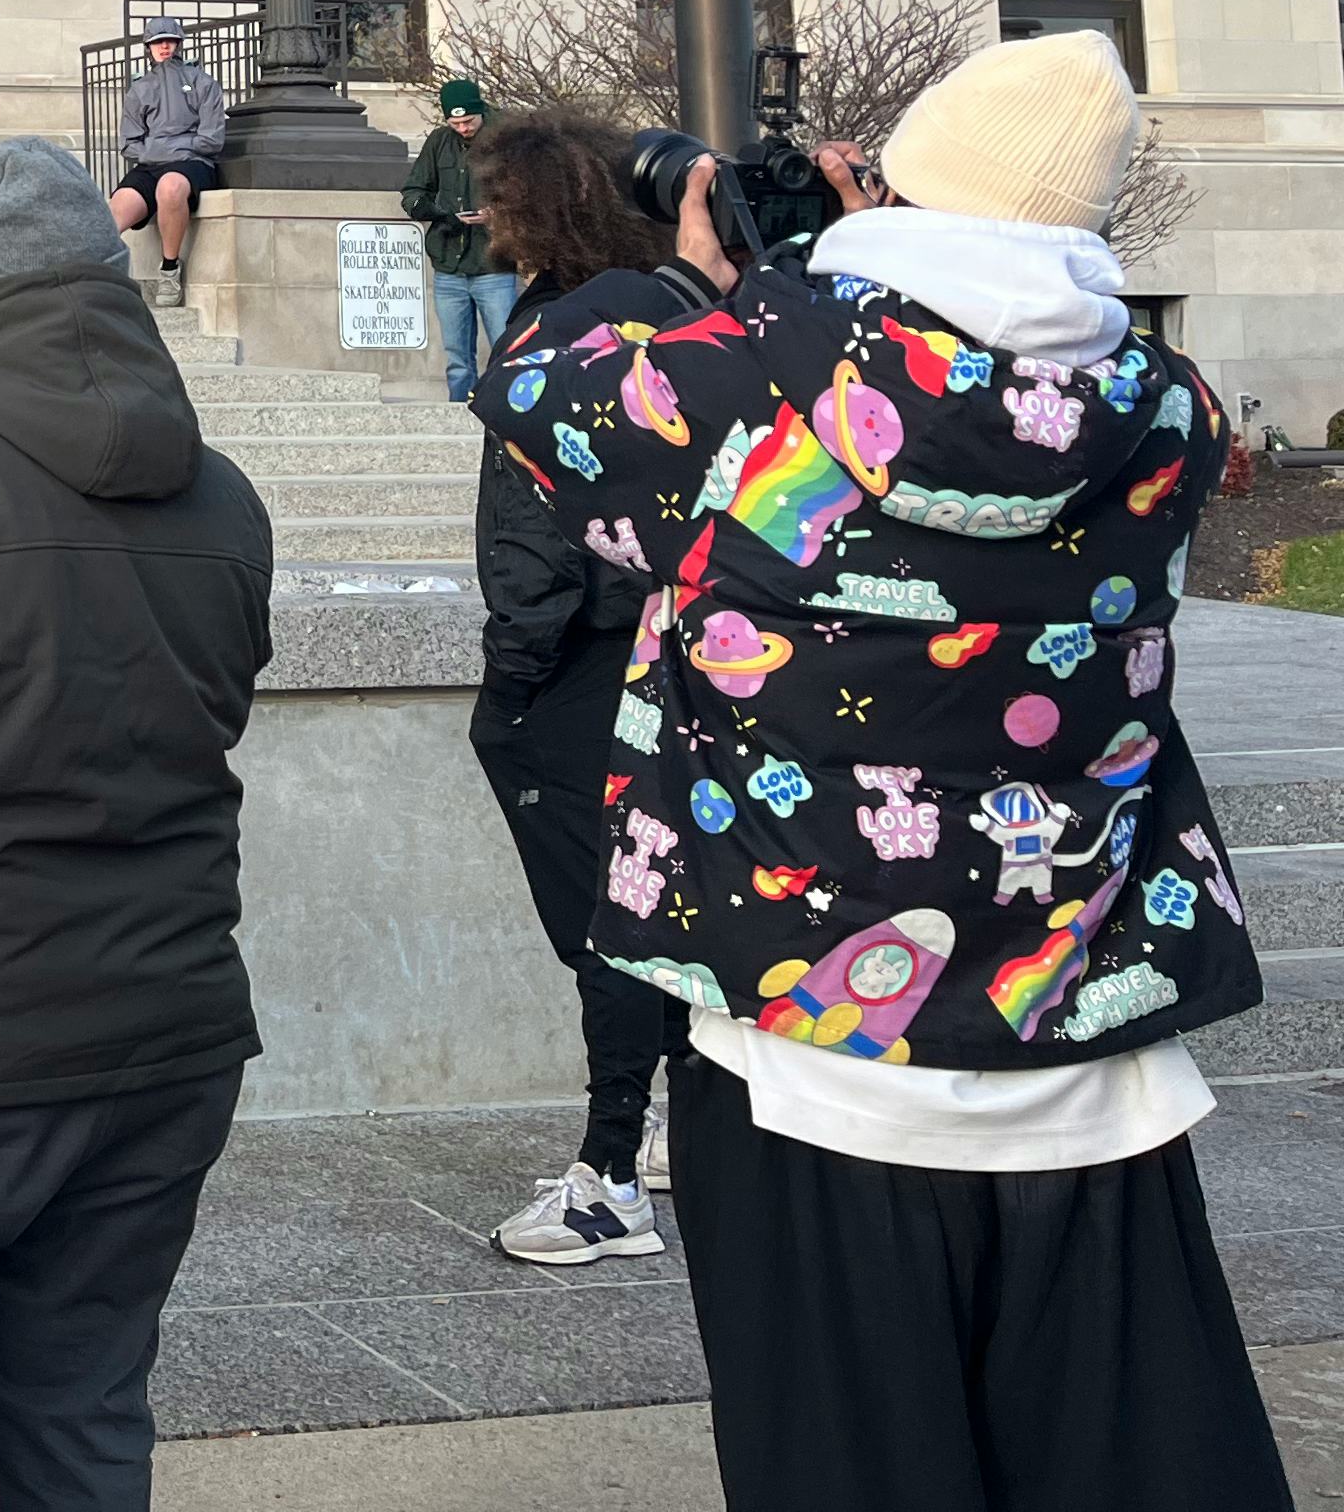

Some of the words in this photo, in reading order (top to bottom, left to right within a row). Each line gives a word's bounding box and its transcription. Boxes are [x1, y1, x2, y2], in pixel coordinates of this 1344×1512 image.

[374, 226, 388, 239] NO
[342, 240, 376, 254] ROLLER
[344, 256, 378, 269] ROLLER
[381, 256, 420, 270] SKATING
[376, 271, 389, 284] OR
[344, 286, 420, 300] SKATEBOARDING
[377, 301, 389, 314] ON
[352, 316, 414, 330] COURTHOUSE
[361, 331, 407, 345] PROPERTY
[1006, 389, 1082, 423] LOVE
[1018, 415, 1074, 448] SKY
[561, 443, 590, 474] YOU
[562, 429, 598, 471] LOVE
[844, 578, 942, 606] TRAVEL
[1040, 625, 1090, 655] LOVE
[1049, 641, 1088, 669] YOU
[858, 766, 917, 789] HEY
[766, 780, 803, 806] YOU
[891, 787, 906, 807] I
[629, 813, 675, 852] HEY
[862, 807, 935, 834] LOVE
[637, 842, 649, 863] I
[877, 832, 934, 855] SKY
[611, 846, 662, 897] LOVE
[612, 878, 652, 915] SKY
[1164, 887, 1192, 922] YOU
[1078, 966, 1161, 1010] TRAVEL
[1067, 1003, 1121, 1036] WITH
[1128, 982, 1176, 1014] STAR
